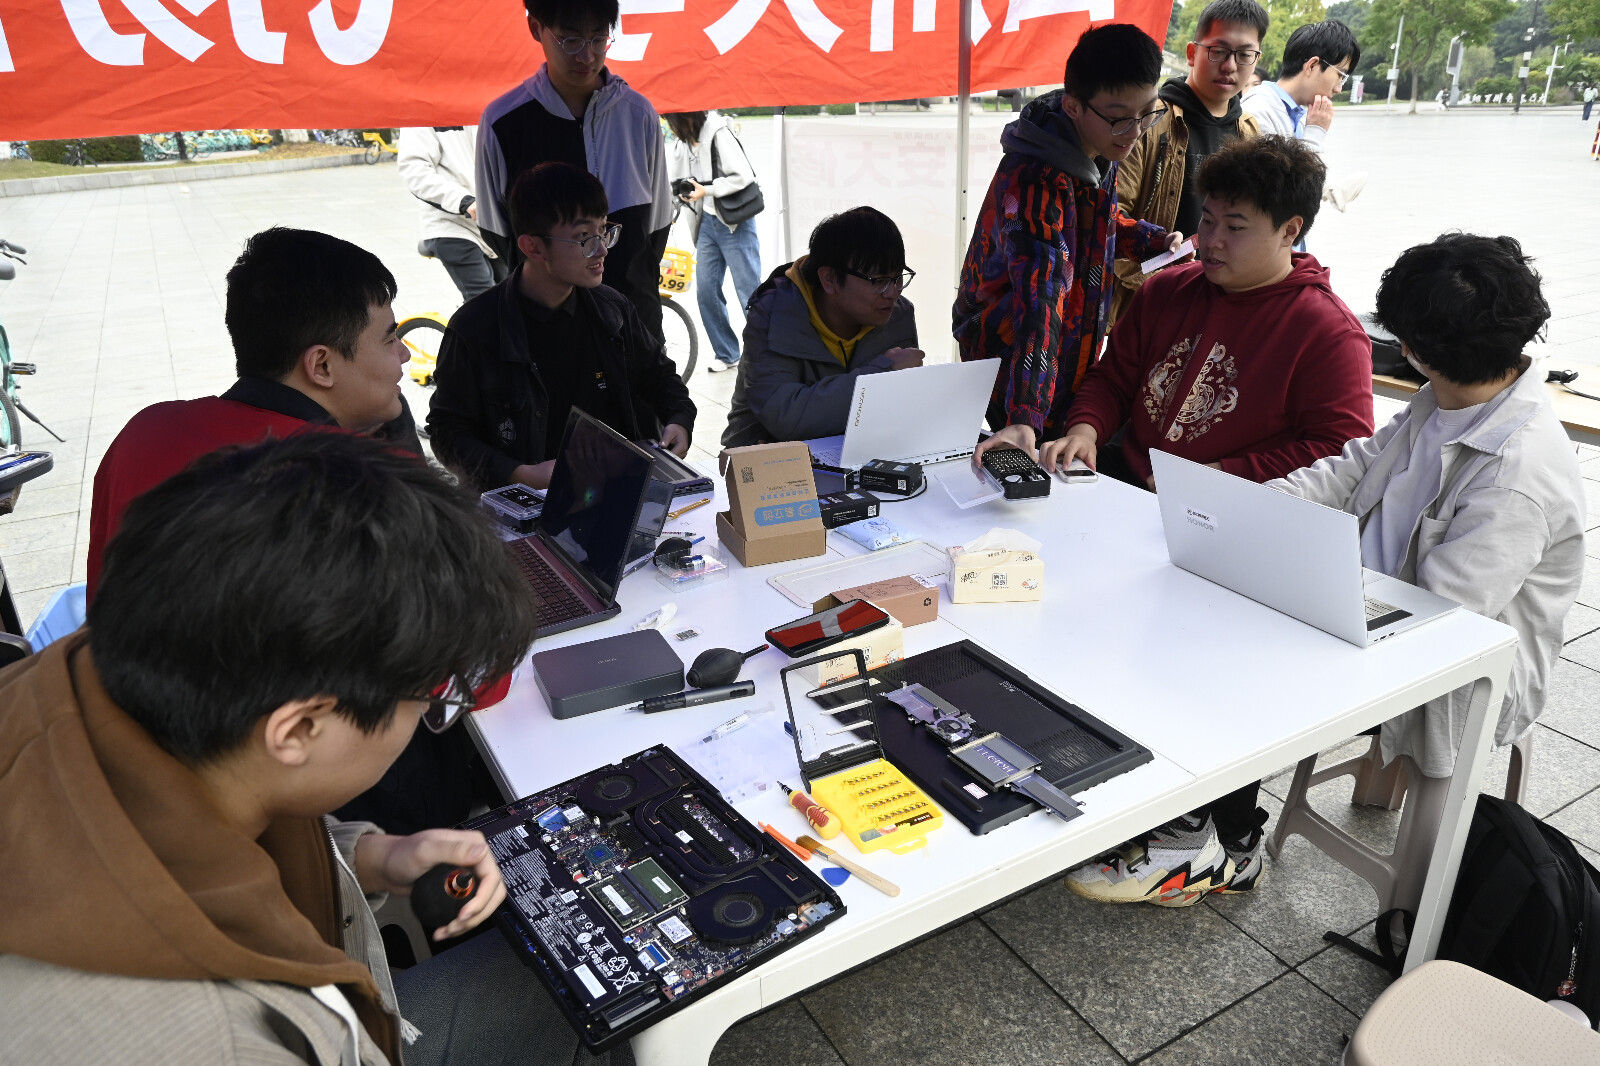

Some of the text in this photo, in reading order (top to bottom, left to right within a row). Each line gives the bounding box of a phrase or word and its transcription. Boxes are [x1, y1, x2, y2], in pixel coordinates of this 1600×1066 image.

[763, 507, 795, 521] 嘉立创
[1187, 516, 1215, 532] HONOR
[977, 748, 1014, 773] LEGION
